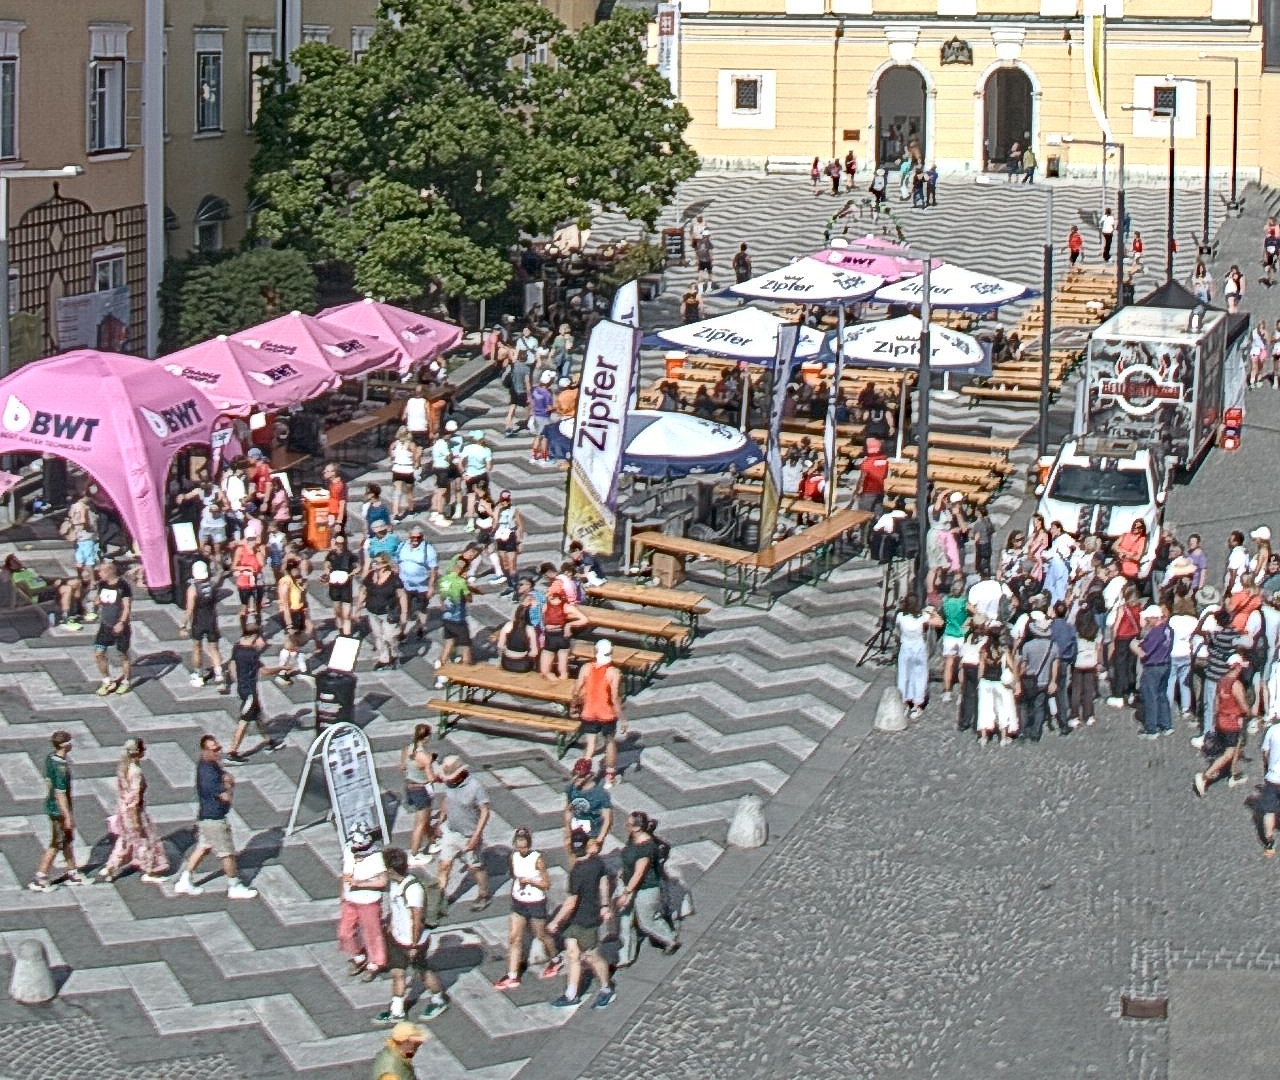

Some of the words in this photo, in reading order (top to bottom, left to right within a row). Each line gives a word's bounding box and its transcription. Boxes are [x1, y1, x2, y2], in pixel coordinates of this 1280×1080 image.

[759, 278, 815, 293] Zipfer
[693, 326, 753, 347] Zipfer
[873, 340, 941, 357] Zipfr
[160, 398, 203, 433] BWT
[577, 355, 619, 451] Zipfer
[30, 410, 99, 442] BWT
